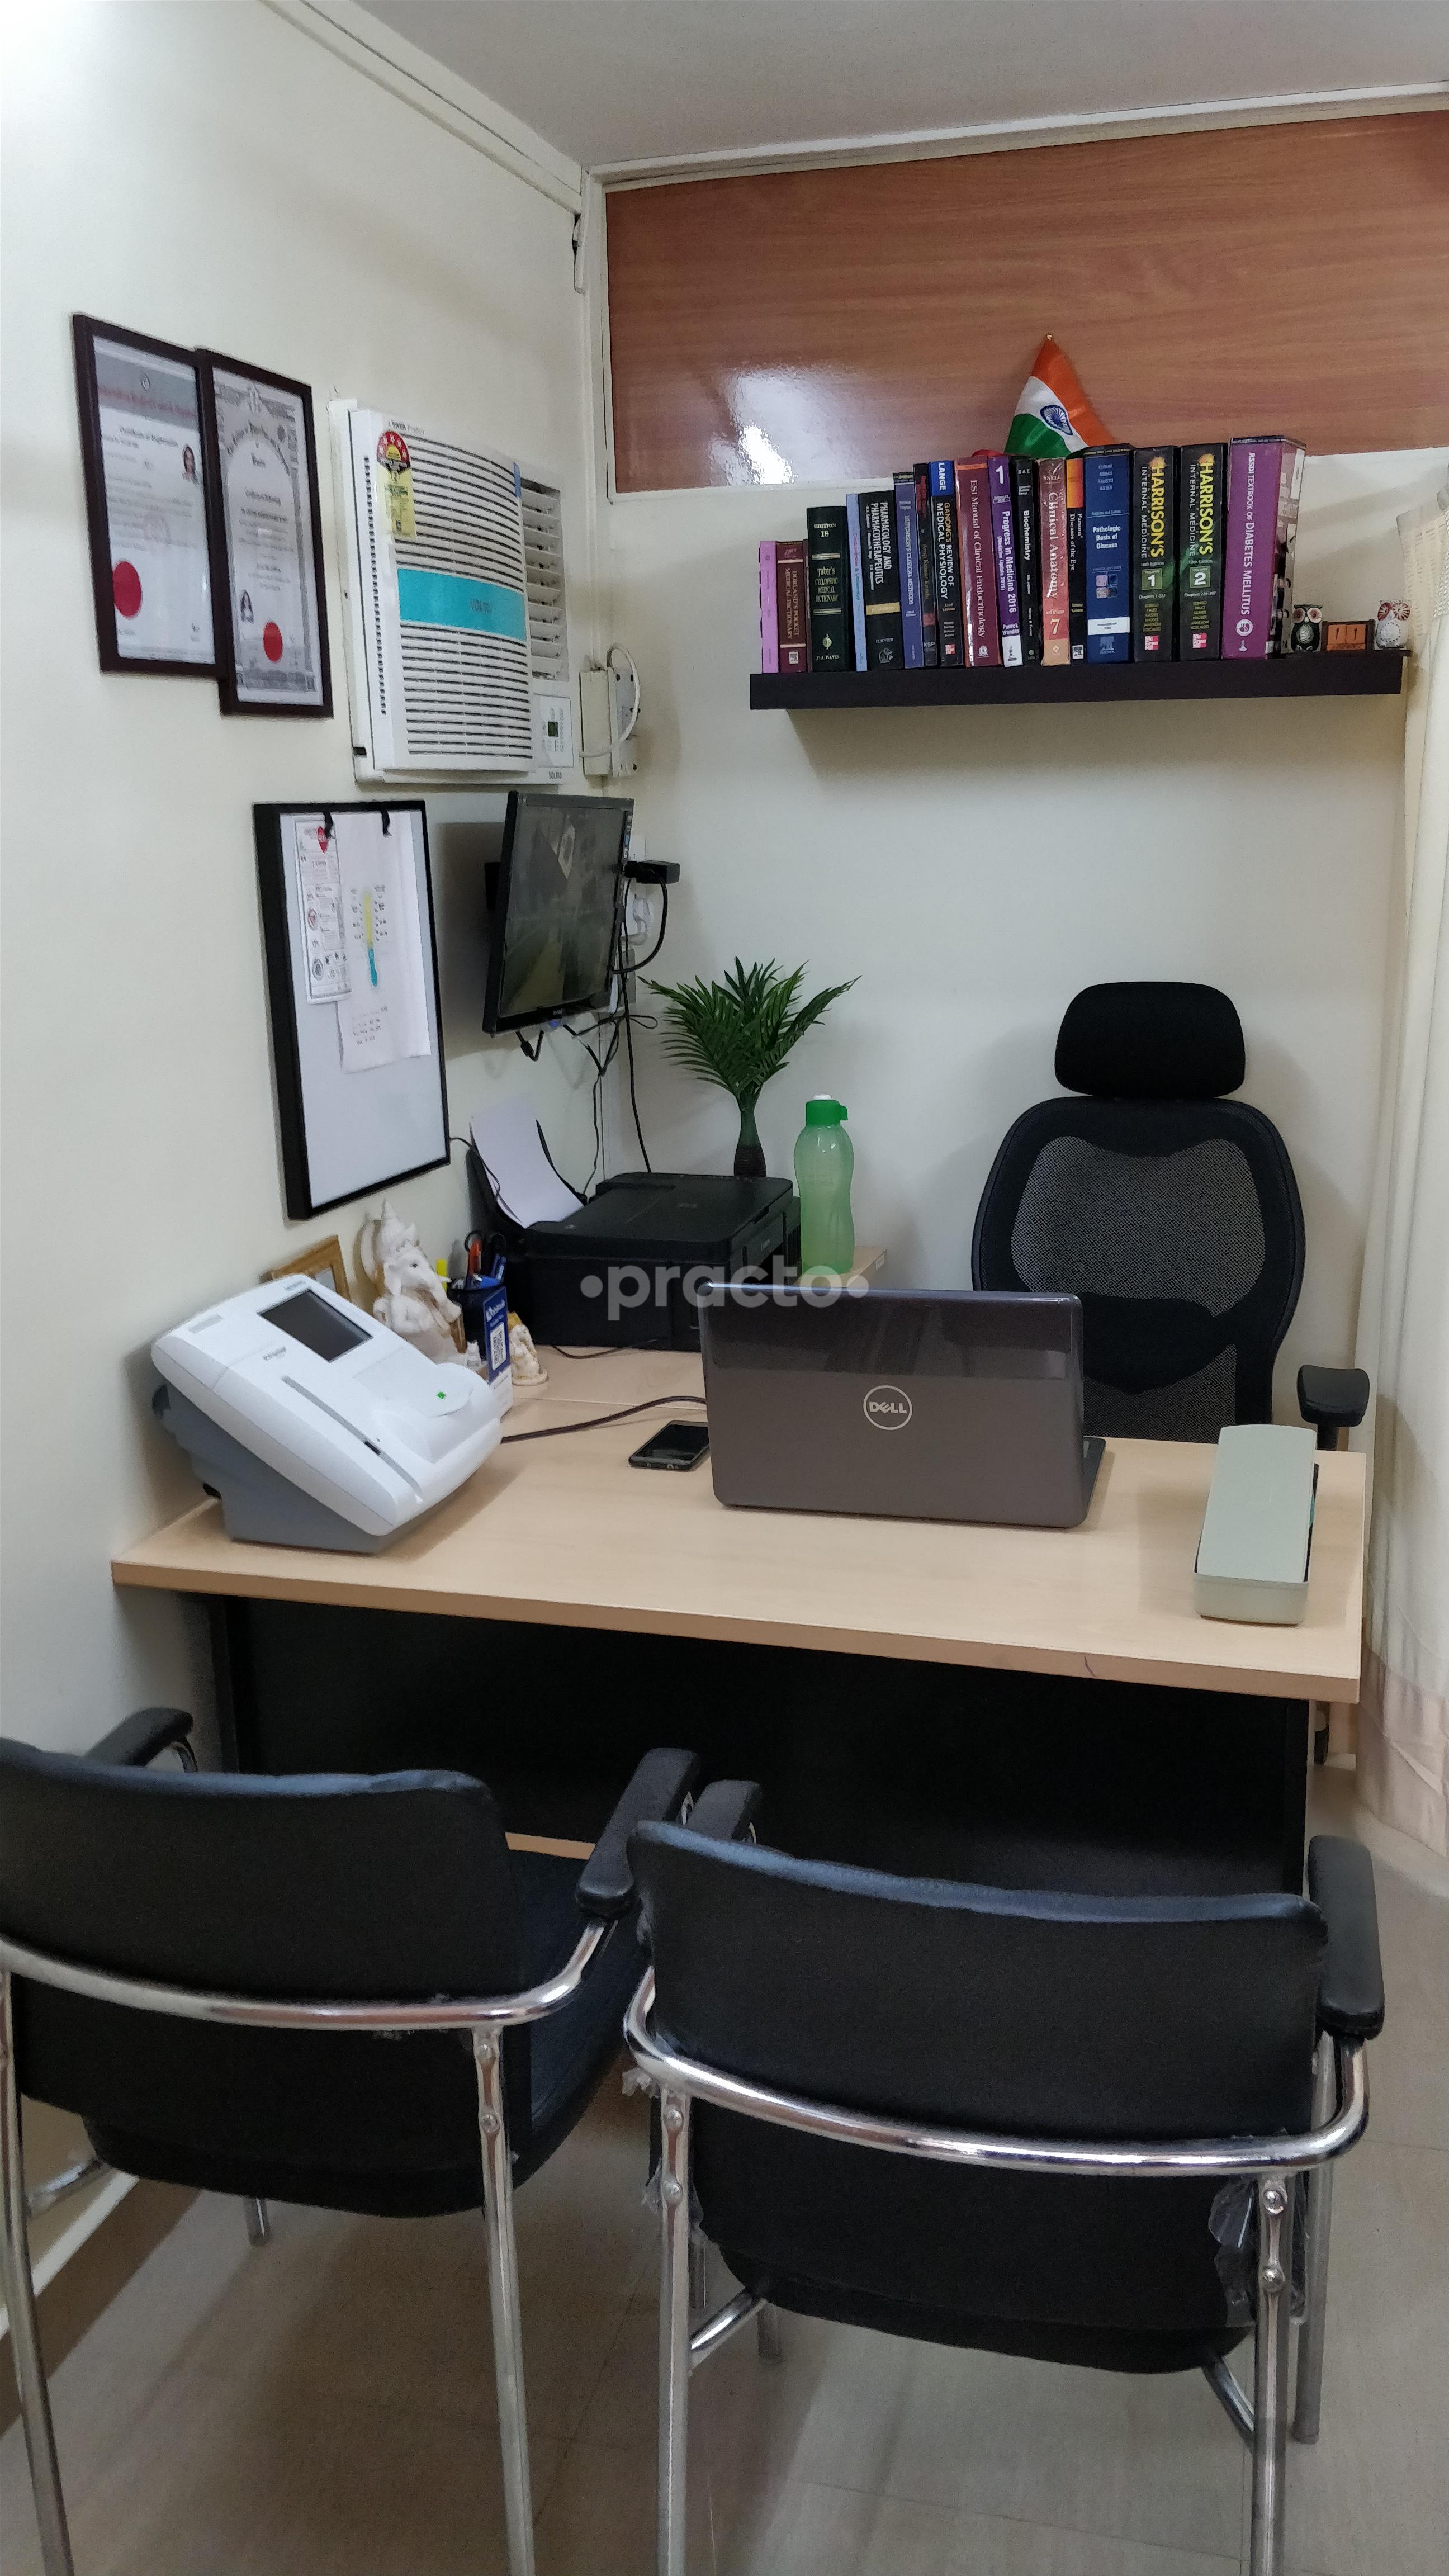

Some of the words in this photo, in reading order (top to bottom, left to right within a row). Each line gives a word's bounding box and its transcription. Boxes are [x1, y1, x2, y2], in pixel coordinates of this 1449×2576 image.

[996, 465, 1004, 484] 1
[972, 497, 980, 528] Manual
[1048, 492, 1059, 539] Clinical
[1150, 466, 1165, 557] HARRISON'S
[1199, 462, 1213, 555] HARRISON'S
[1247, 512, 1253, 520] OF
[880, 501, 891, 553] PHARMACOLOGY
[973, 531, 980, 541] of
[1002, 510, 1011, 546] Progress
[1093, 525, 1121, 533] Pathologic
[870, 503, 883, 584] PHARMACOTHERAPEUTICS
[974, 542, 983, 573] Clinical
[1243, 522, 1254, 567] DIABETES
[817, 567, 836, 576] Taber's
[883, 556, 892, 570] AND
[939, 544, 948, 599] PHYSIOLOGY
[1006, 556, 1015, 591] Medicine
[1049, 544, 1059, 599] Anatomy
[1194, 572, 1206, 585] 2
[948, 574, 954, 586] OF
[1148, 574, 1156, 586] 1
[1241, 570, 1252, 615] MELLITUS
[976, 576, 985, 638] Endocrinology
[1008, 593, 1017, 613] 2016
[1050, 618, 1060, 634] 7
[869, 1401, 907, 1414] DELL
